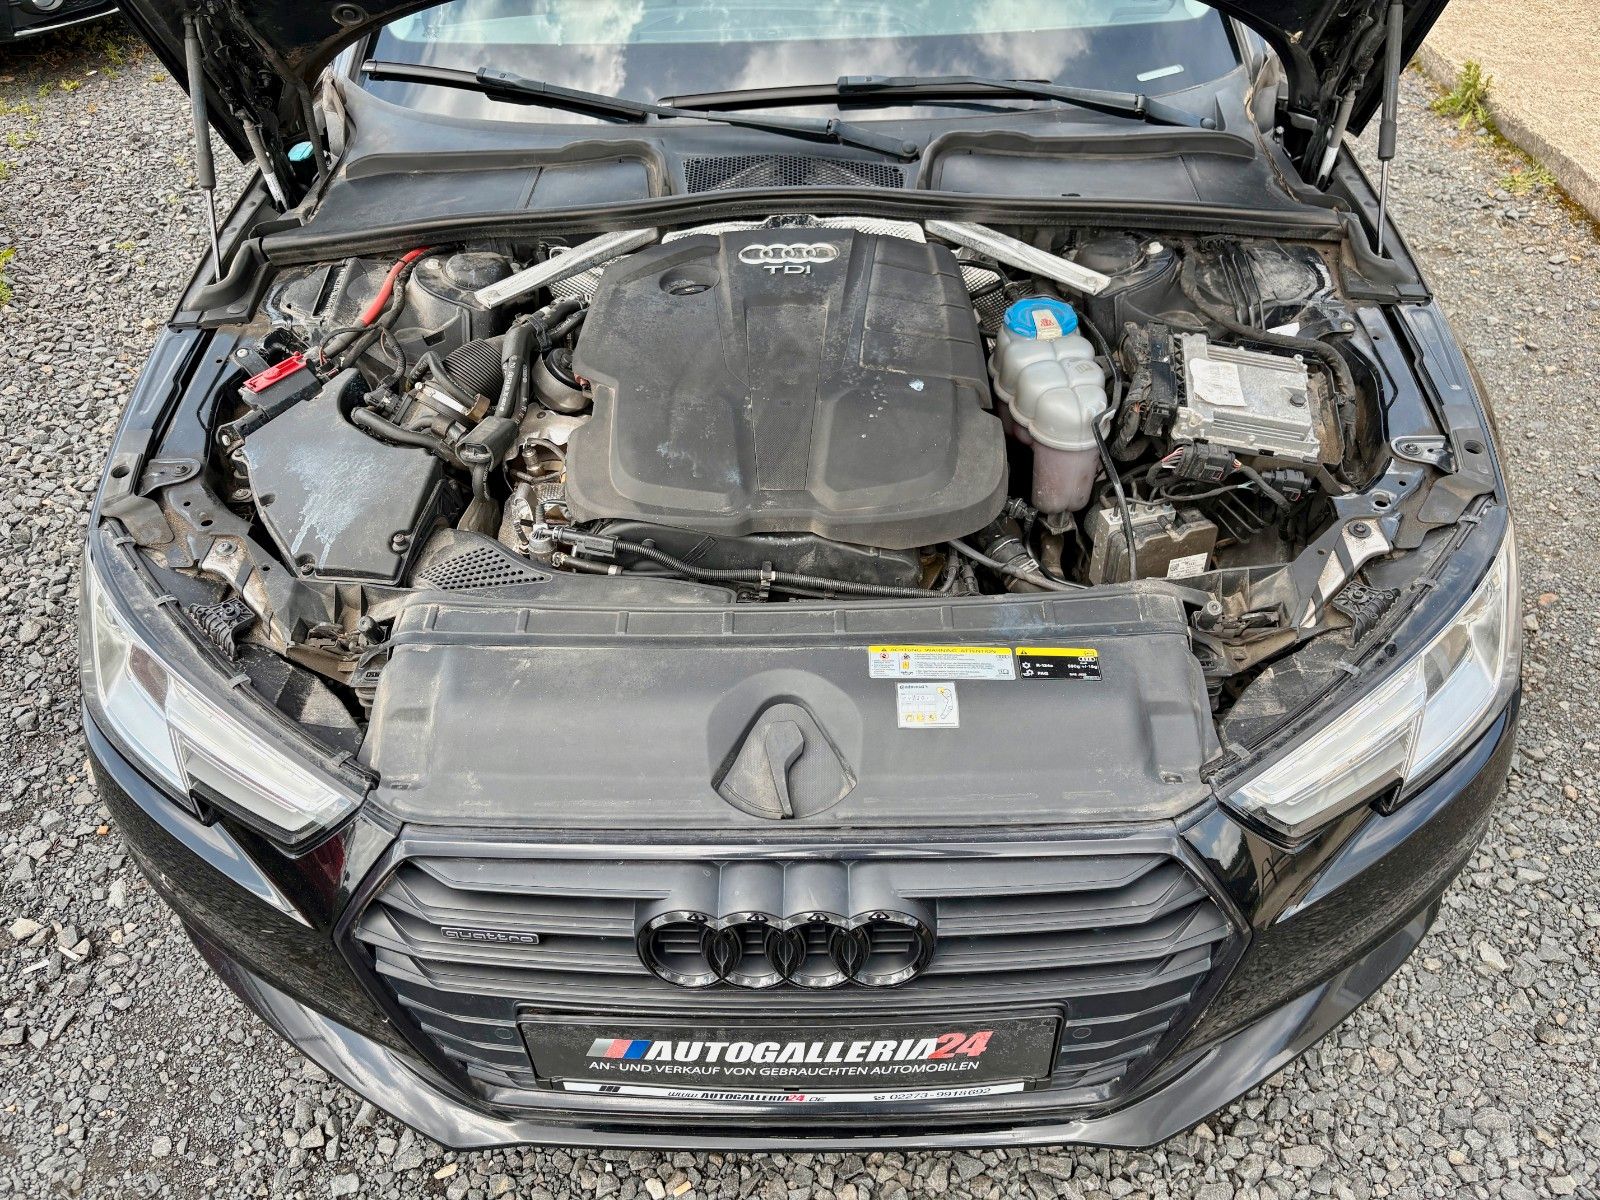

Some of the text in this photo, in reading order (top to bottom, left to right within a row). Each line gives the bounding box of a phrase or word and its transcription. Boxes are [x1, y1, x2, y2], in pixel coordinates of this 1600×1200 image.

[763, 264, 811, 274] TDI
[446, 930, 534, 943] quattro
[643, 1029, 995, 1064] AUTOGALLERIA24
[589, 1061, 980, 1077] AN- UND VERKAUF VON GEBRAUCHTEN AUTOMOBILEN
